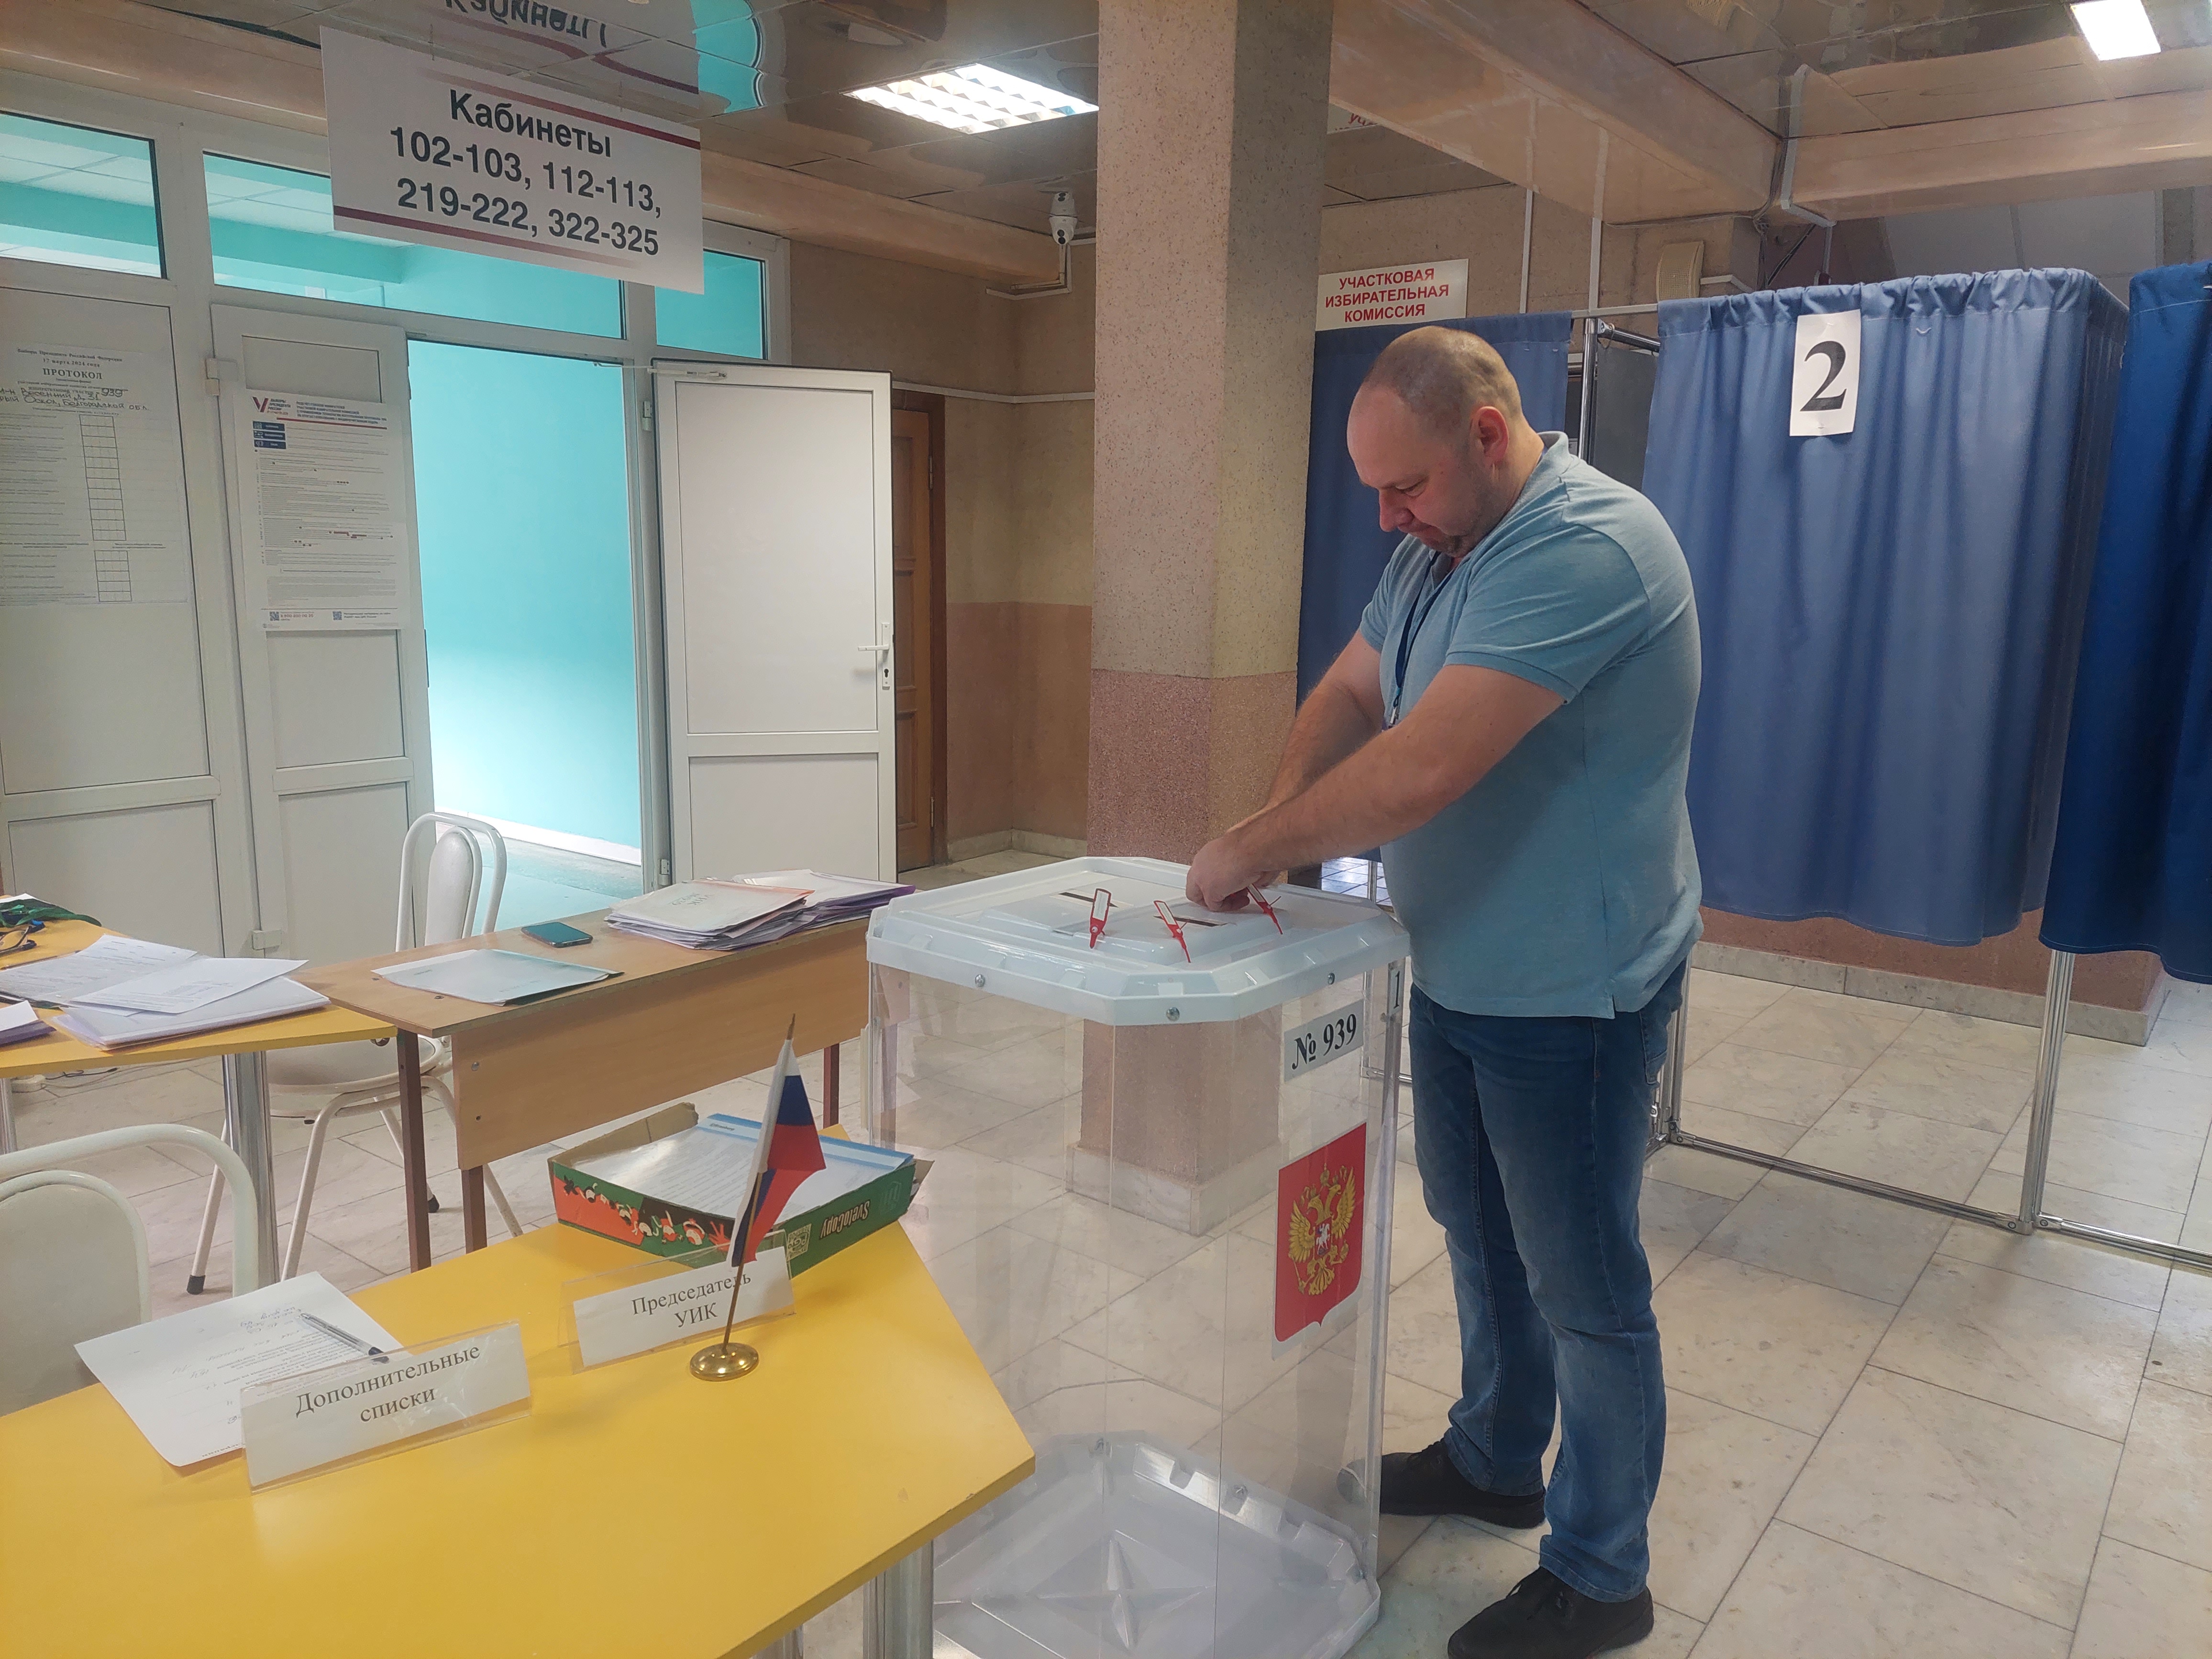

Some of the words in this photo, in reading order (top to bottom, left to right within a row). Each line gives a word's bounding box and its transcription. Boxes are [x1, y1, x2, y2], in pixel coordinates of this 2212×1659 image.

[450, 89, 611, 157] Кабинеты
[390, 127, 531, 190] 102-103,
[542, 162, 661, 218] 112-113,
[398, 178, 537, 238] 219-222,
[548, 209, 658, 255] 322-325
[1339, 268, 1435, 289] УЧАСТКОВАЯ
[1326, 284, 1449, 308] ИЗБИРАТЕЛЬНАЯ
[1345, 304, 1425, 322] КОМИССИЯ
[43, 368, 102, 379] ПРОТОКОЛ
[1800, 341, 1847, 411] 2
[101, 387, 123, 397] 939
[1292, 1033, 1316, 1070] №
[1323, 1014, 1356, 1056] 939
[675, 1302, 718, 1328] УИК
[295, 1347, 480, 1418] Дополнительные
[360, 1388, 436, 1422] списки
